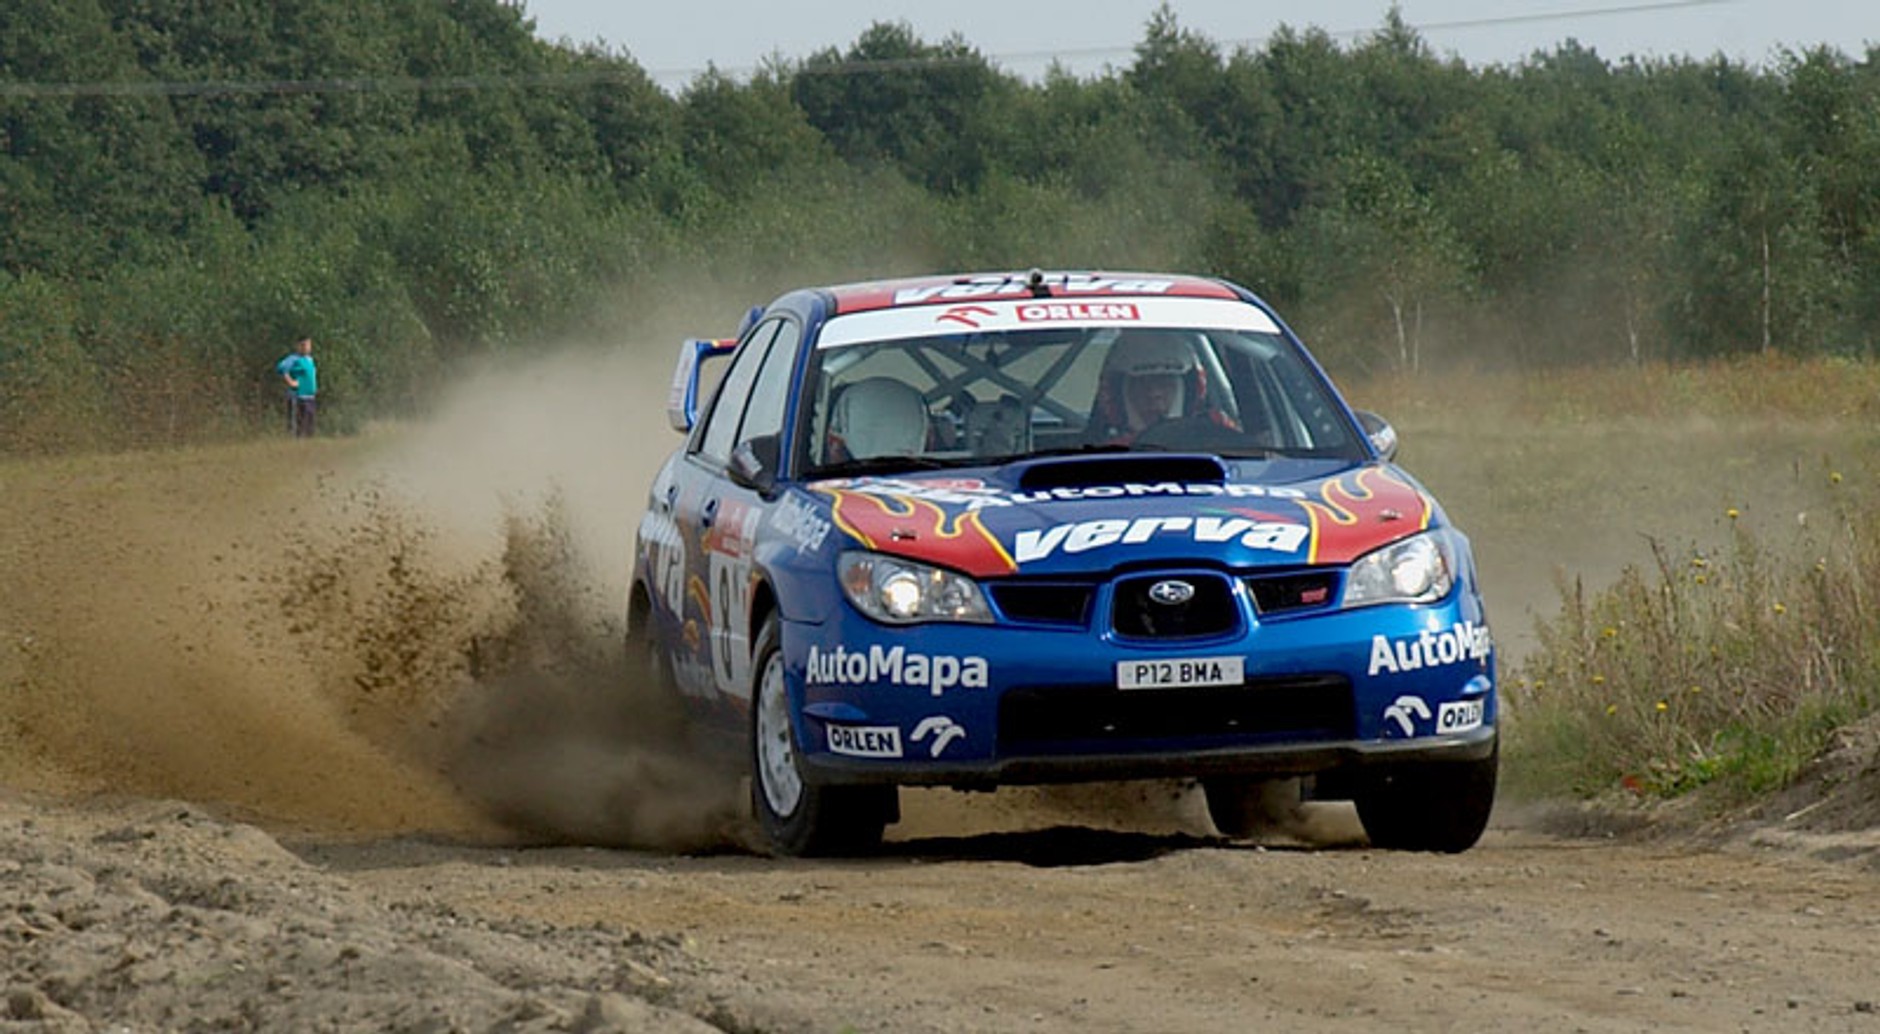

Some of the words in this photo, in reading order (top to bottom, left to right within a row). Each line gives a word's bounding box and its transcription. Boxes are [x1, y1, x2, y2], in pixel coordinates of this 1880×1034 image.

[1022, 304, 1134, 321] ORLEN
[965, 482, 1307, 511] AutoMapa
[1015, 517, 1310, 564] verva
[806, 645, 988, 696] AutoMapa
[1135, 663, 1173, 684] P12
[1179, 661, 1223, 683] BMA
[831, 728, 895, 752] ORLEN
